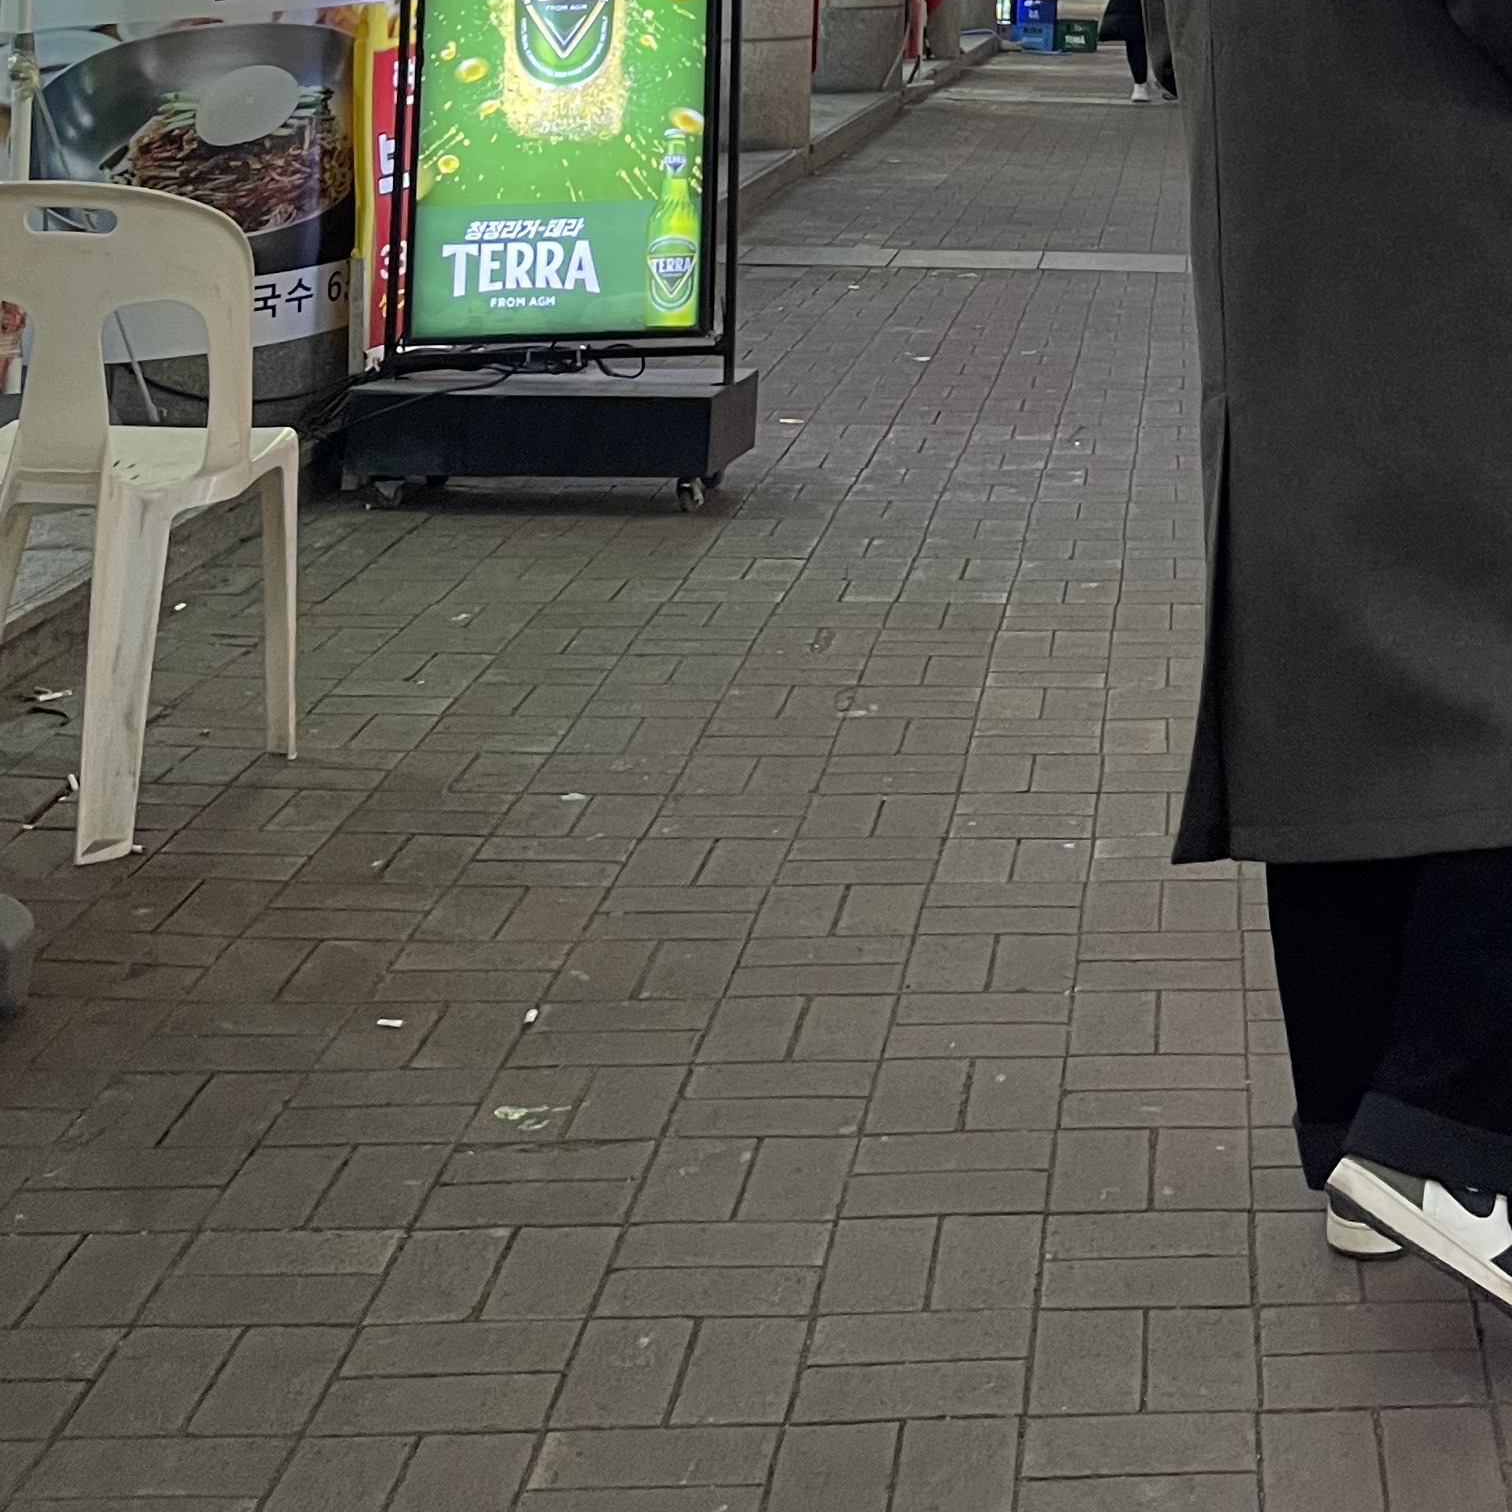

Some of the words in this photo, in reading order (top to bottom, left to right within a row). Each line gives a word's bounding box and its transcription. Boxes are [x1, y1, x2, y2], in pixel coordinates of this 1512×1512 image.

[441, 241, 601, 295] TERRA
[651, 255, 693, 272] TERRA
[490, 296, 523, 308] FROM
[526, 295, 556, 307] AGM
